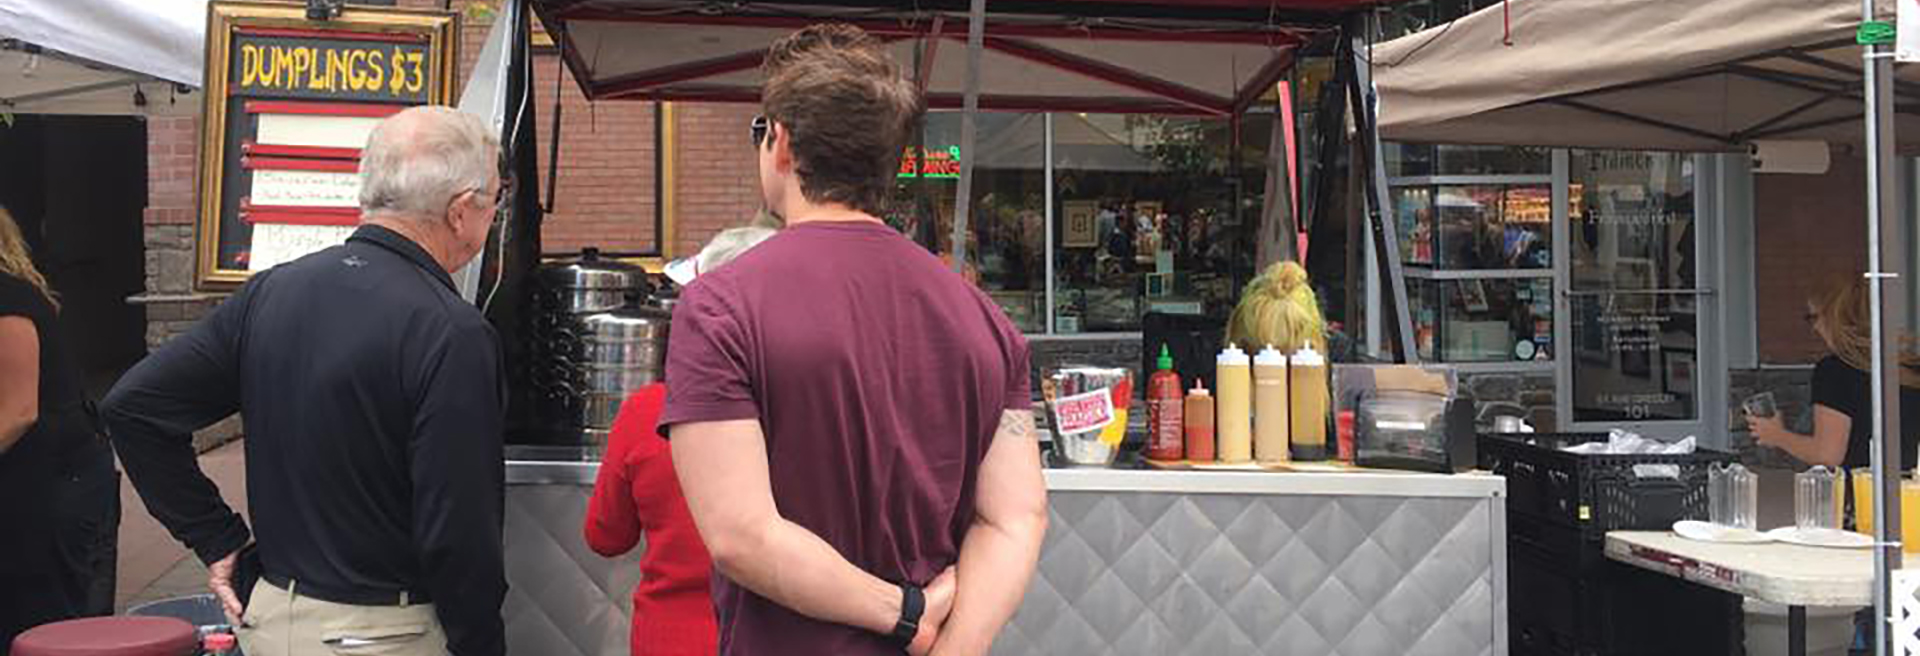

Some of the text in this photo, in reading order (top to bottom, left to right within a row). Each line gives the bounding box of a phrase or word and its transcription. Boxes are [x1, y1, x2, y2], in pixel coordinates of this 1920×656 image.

[241, 44, 423, 96] DUMPLINGS $3
[1622, 404, 1650, 419] 101
